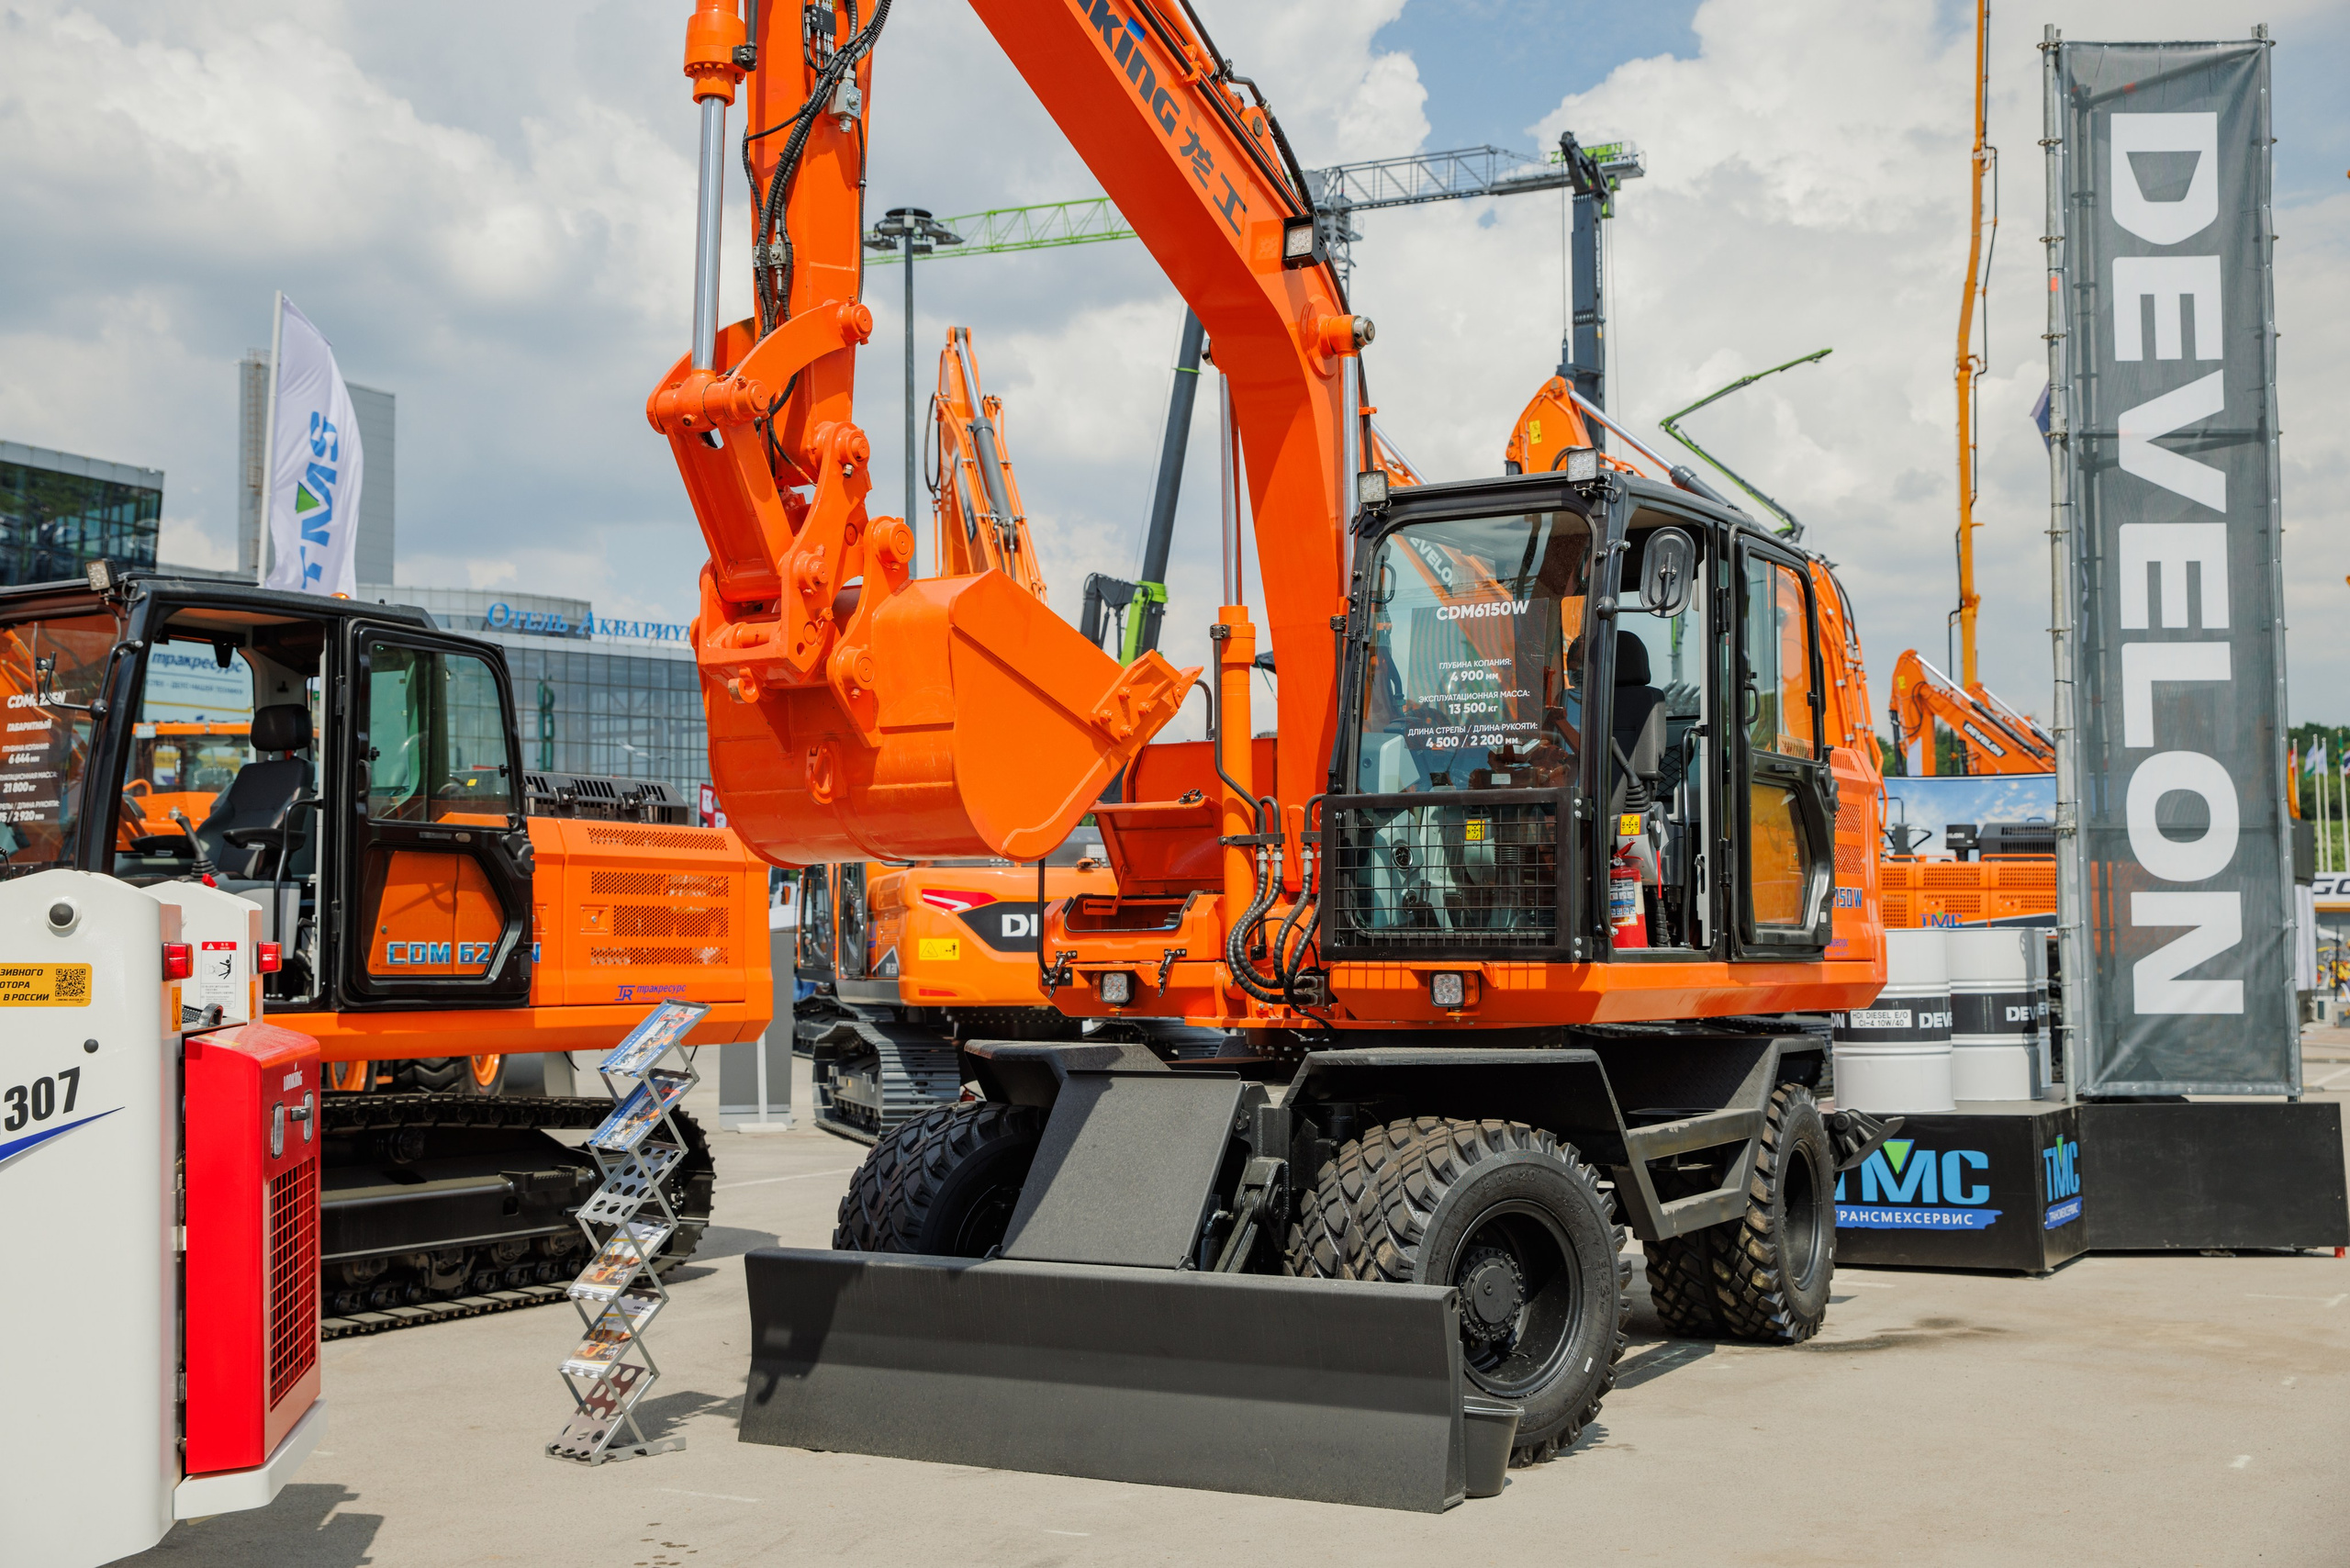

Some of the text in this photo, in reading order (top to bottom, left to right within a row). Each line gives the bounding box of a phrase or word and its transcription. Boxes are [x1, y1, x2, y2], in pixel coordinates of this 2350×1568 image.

[1076, 0, 1181, 137] KING
[2110, 112, 2244, 1014] DEVELON
[1437, 600, 1530, 621] CDM6150W
[1439, 658, 1513, 670] ГЛУБИНА КОПАНИЯ:
[1451, 670, 1499, 681] 4 900 мм
[1418, 690, 1530, 703] ЭКСПЛУАТАЦИОННАЯ МАССА:
[1449, 702, 1498, 714] 13 500 кг
[1408, 728, 1434, 737] ДЛИНА
[1436, 726, 1466, 734] СТРЕЛЫ
[1473, 724, 1500, 734] ДЛИНА
[1501, 722, 1538, 731] РУКОЯТИ:
[1426, 737, 1433, 748] 4
[1436, 736, 1460, 747] 500
[1461, 734, 1469, 747] /
[1471, 735, 1478, 746] 2
[1480, 734, 1504, 745] 200
[1964, 722, 2004, 757] DEVELON
[3, 783, 13, 793] 21
[386, 942, 451, 964] CDM
[637, 984, 687, 994] тракресурс
[1895, 1011, 1908, 1019] E/O
